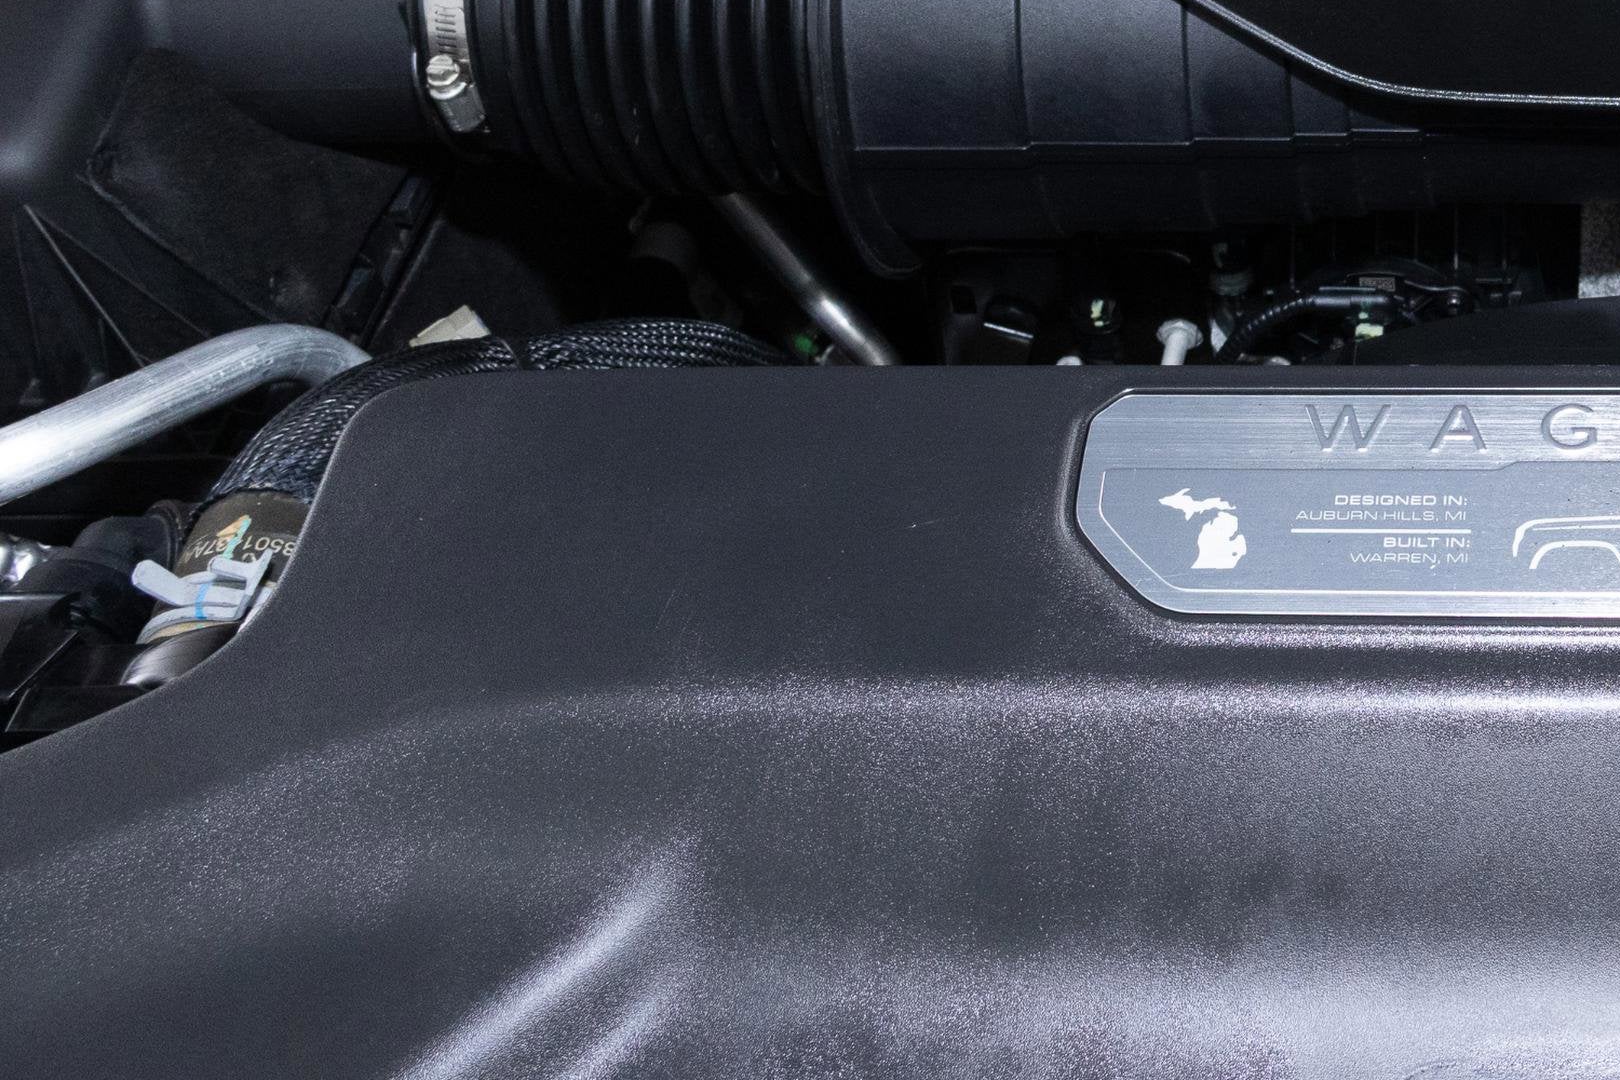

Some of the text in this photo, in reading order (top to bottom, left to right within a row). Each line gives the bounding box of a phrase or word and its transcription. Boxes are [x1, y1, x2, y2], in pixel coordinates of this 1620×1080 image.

[1334, 495, 1468, 506] DESIGNED IN:
[1295, 510, 1467, 522] AUBURN HILLS, MI
[1383, 536, 1471, 548] BUILT IN:
[1350, 552, 1469, 565] WARREN, MI
